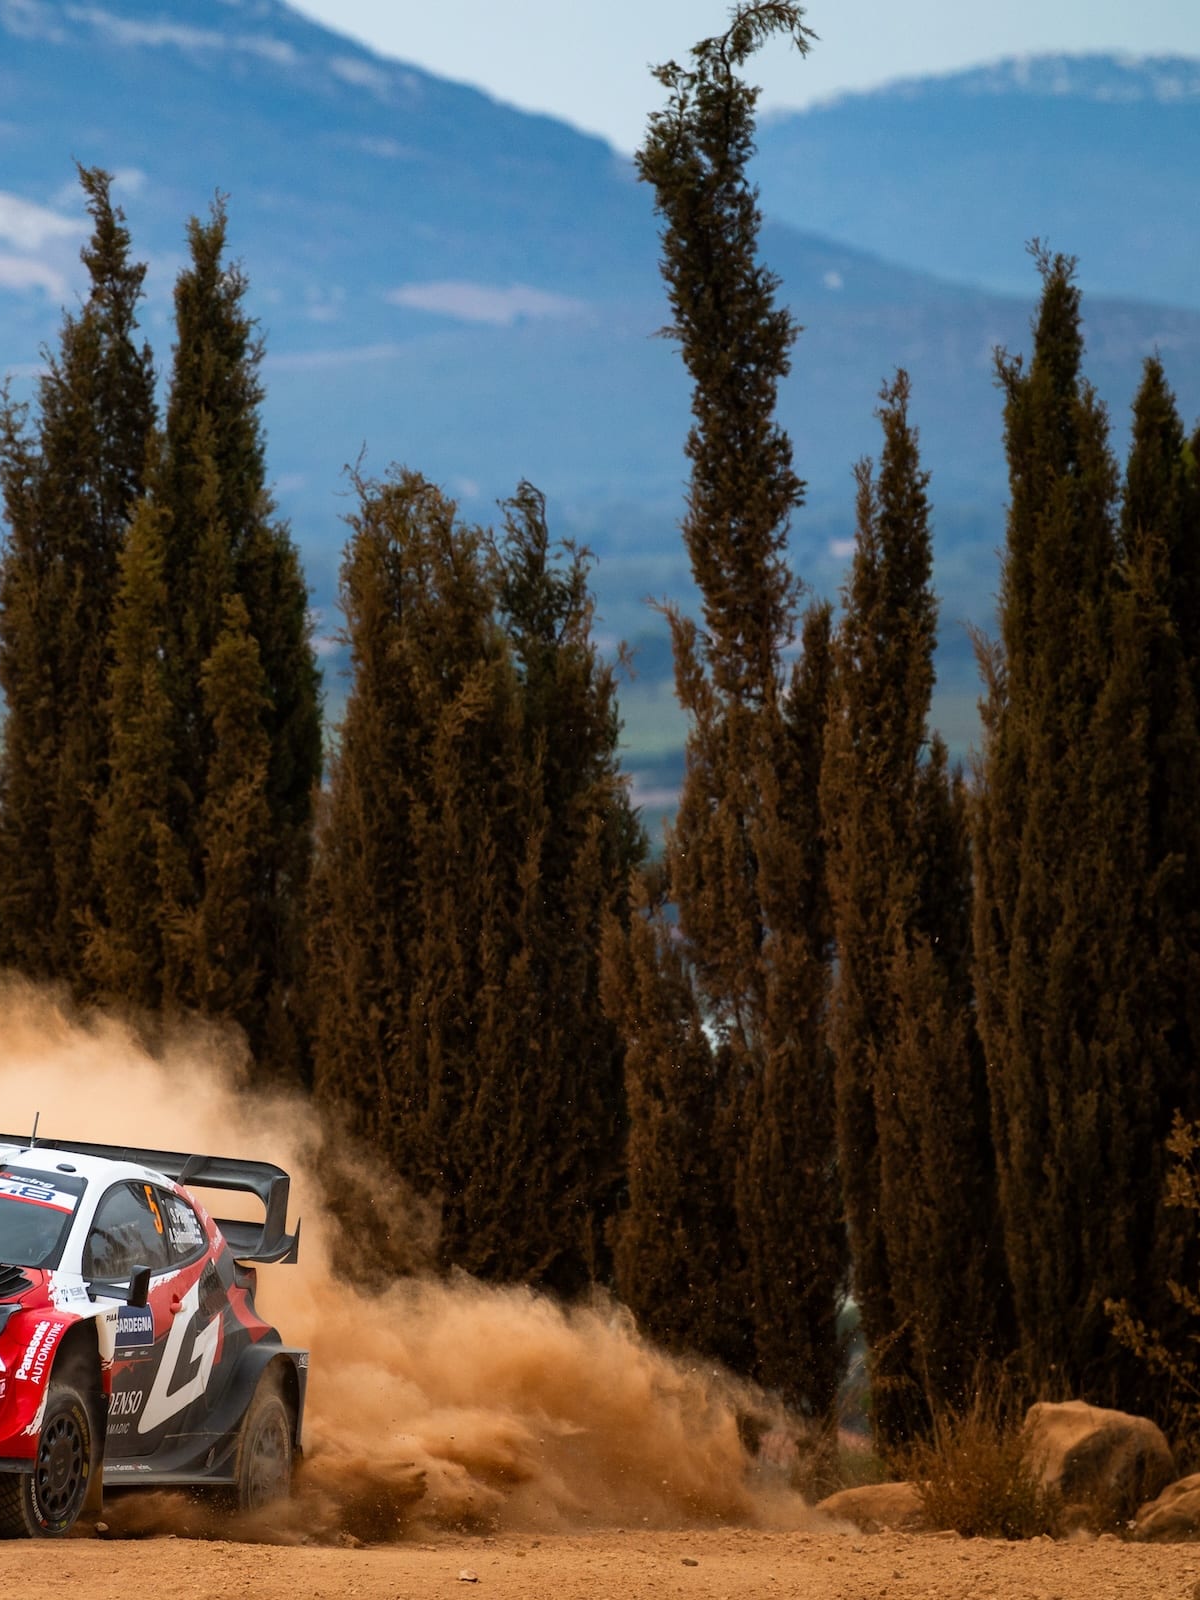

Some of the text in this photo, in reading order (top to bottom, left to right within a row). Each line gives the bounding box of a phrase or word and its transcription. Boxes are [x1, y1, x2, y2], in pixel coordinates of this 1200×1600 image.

[143, 1185, 164, 1235] 5
[15, 1320, 51, 1380] Panasonic
[31, 1322, 64, 1385] AUTOMOTIVE
